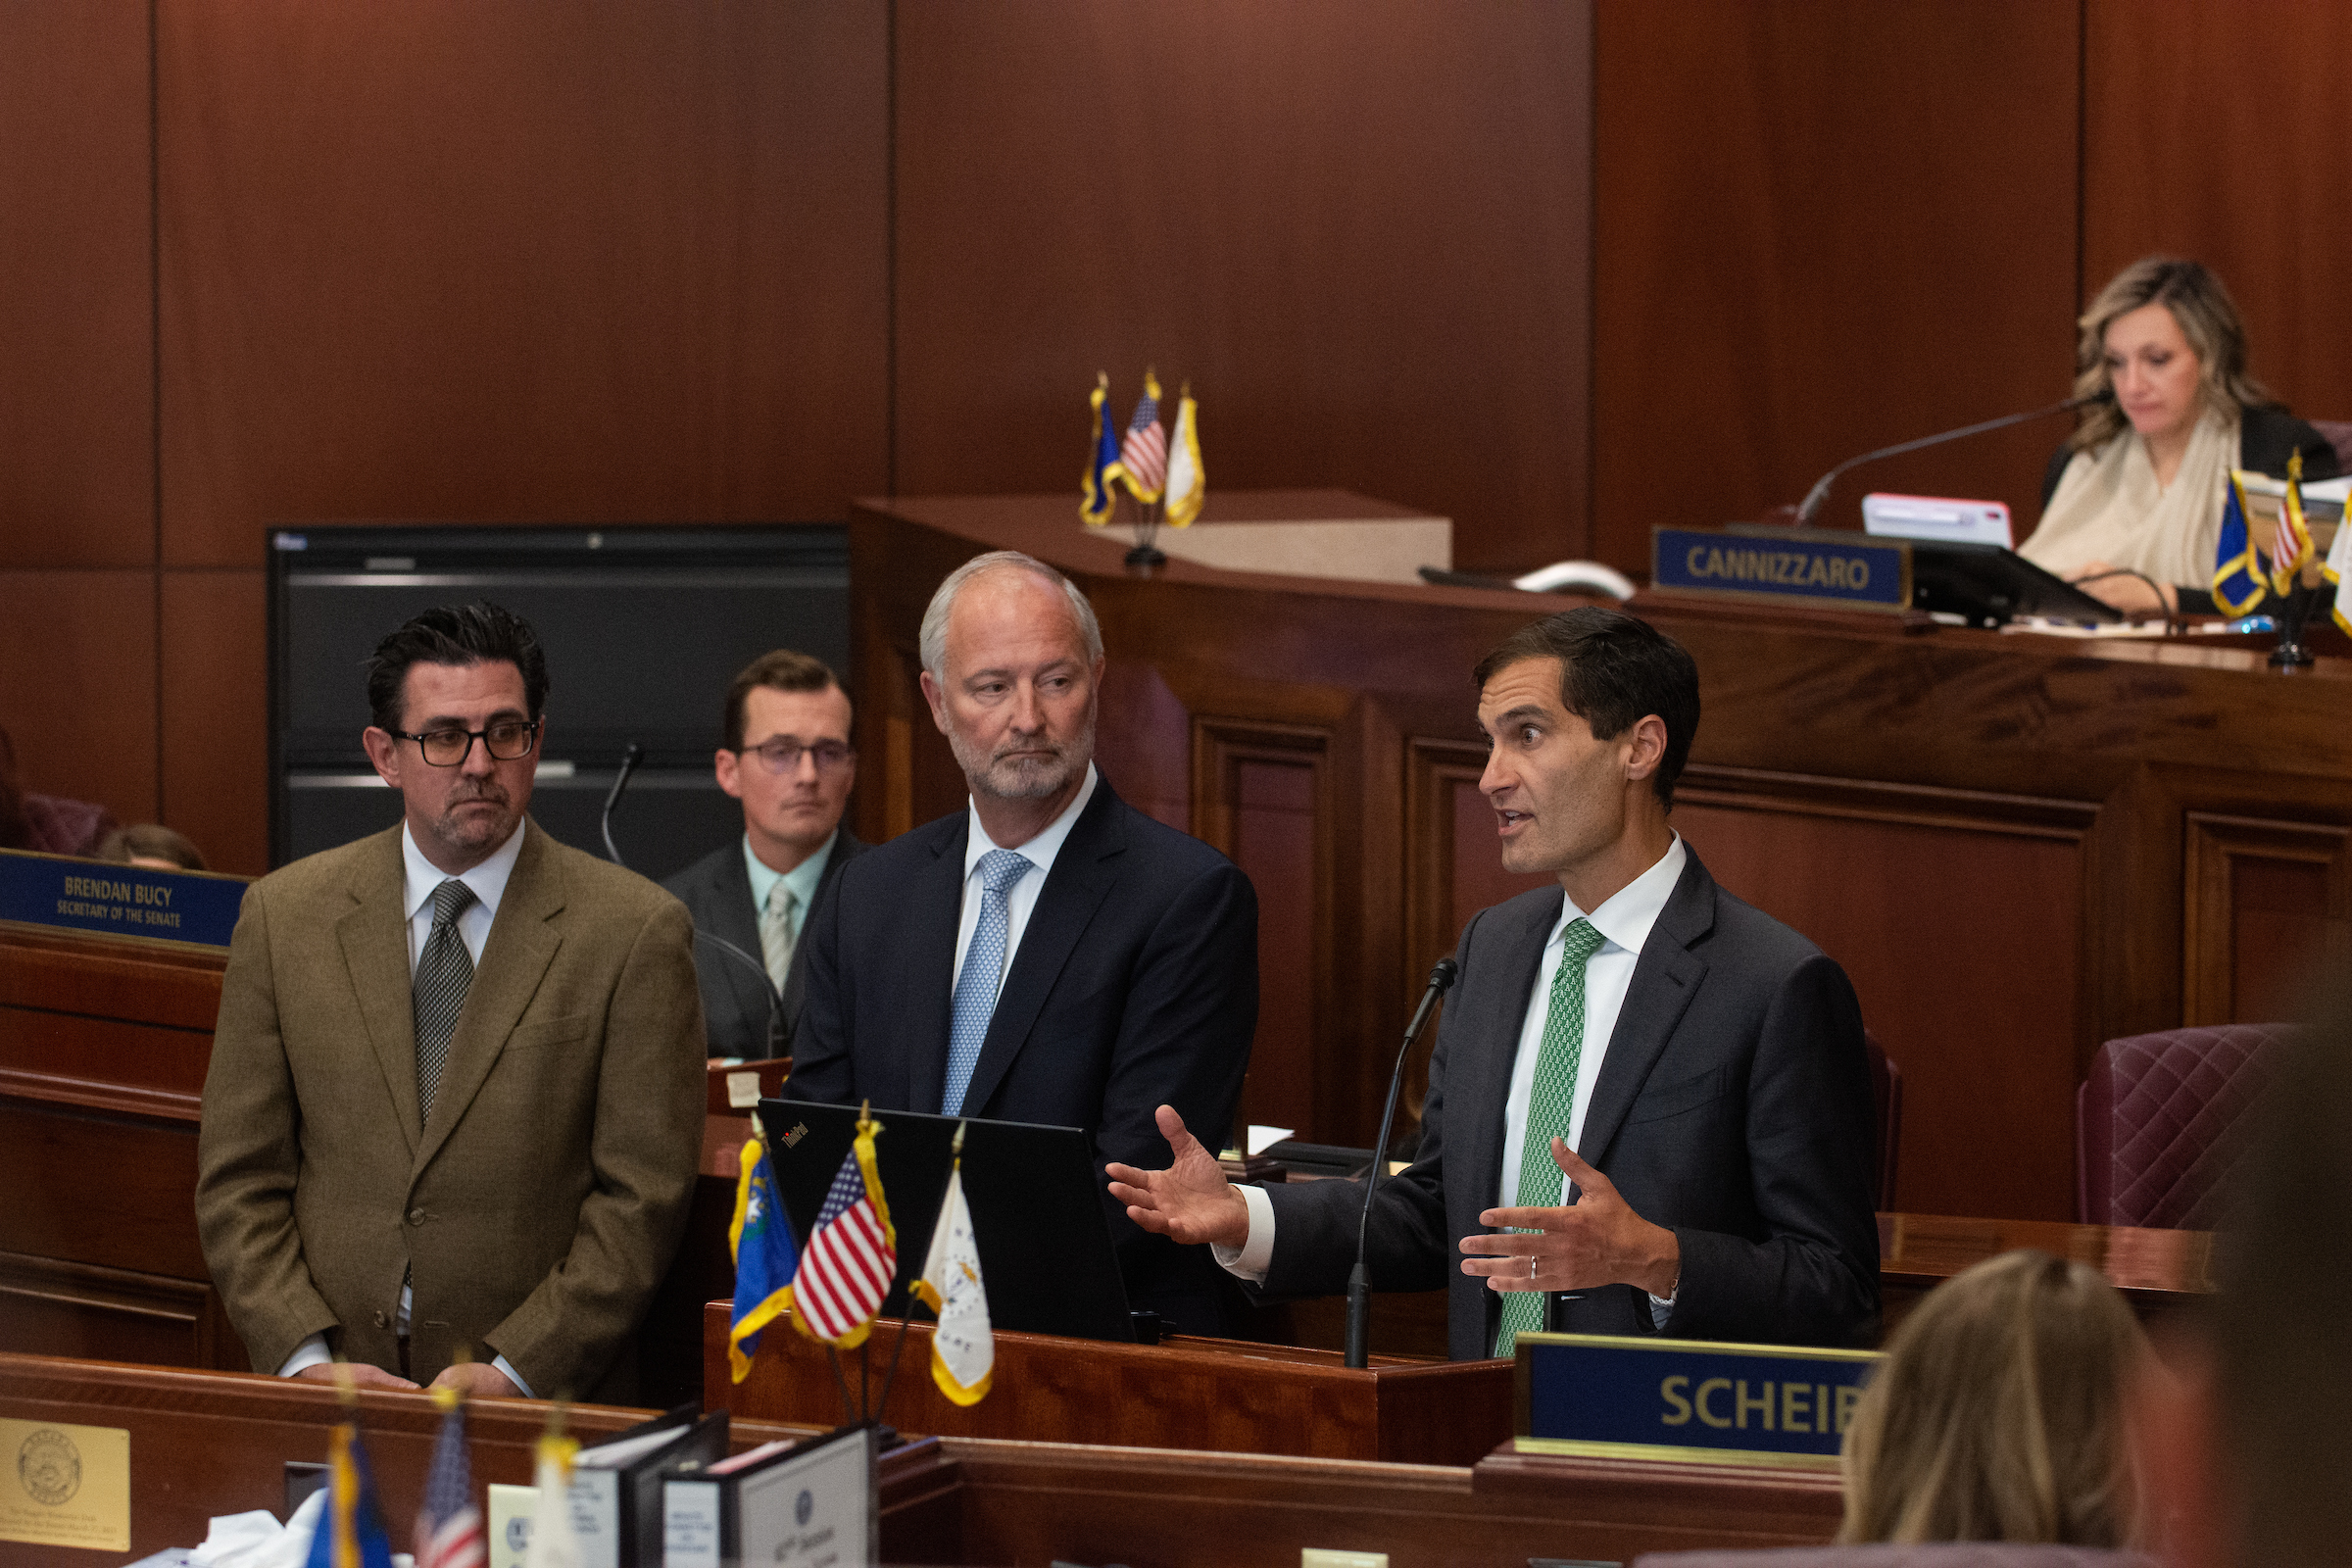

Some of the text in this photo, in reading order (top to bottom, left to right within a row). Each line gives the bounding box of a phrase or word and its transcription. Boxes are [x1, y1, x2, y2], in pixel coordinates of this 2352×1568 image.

[1687, 546, 1870, 590] CANNIZZARO
[65, 876, 172, 906] BRENDAN BUCY
[57, 900, 180, 928] SECRETARY OF THE SENATE
[781, 1121, 808, 1149] ThinkPad
